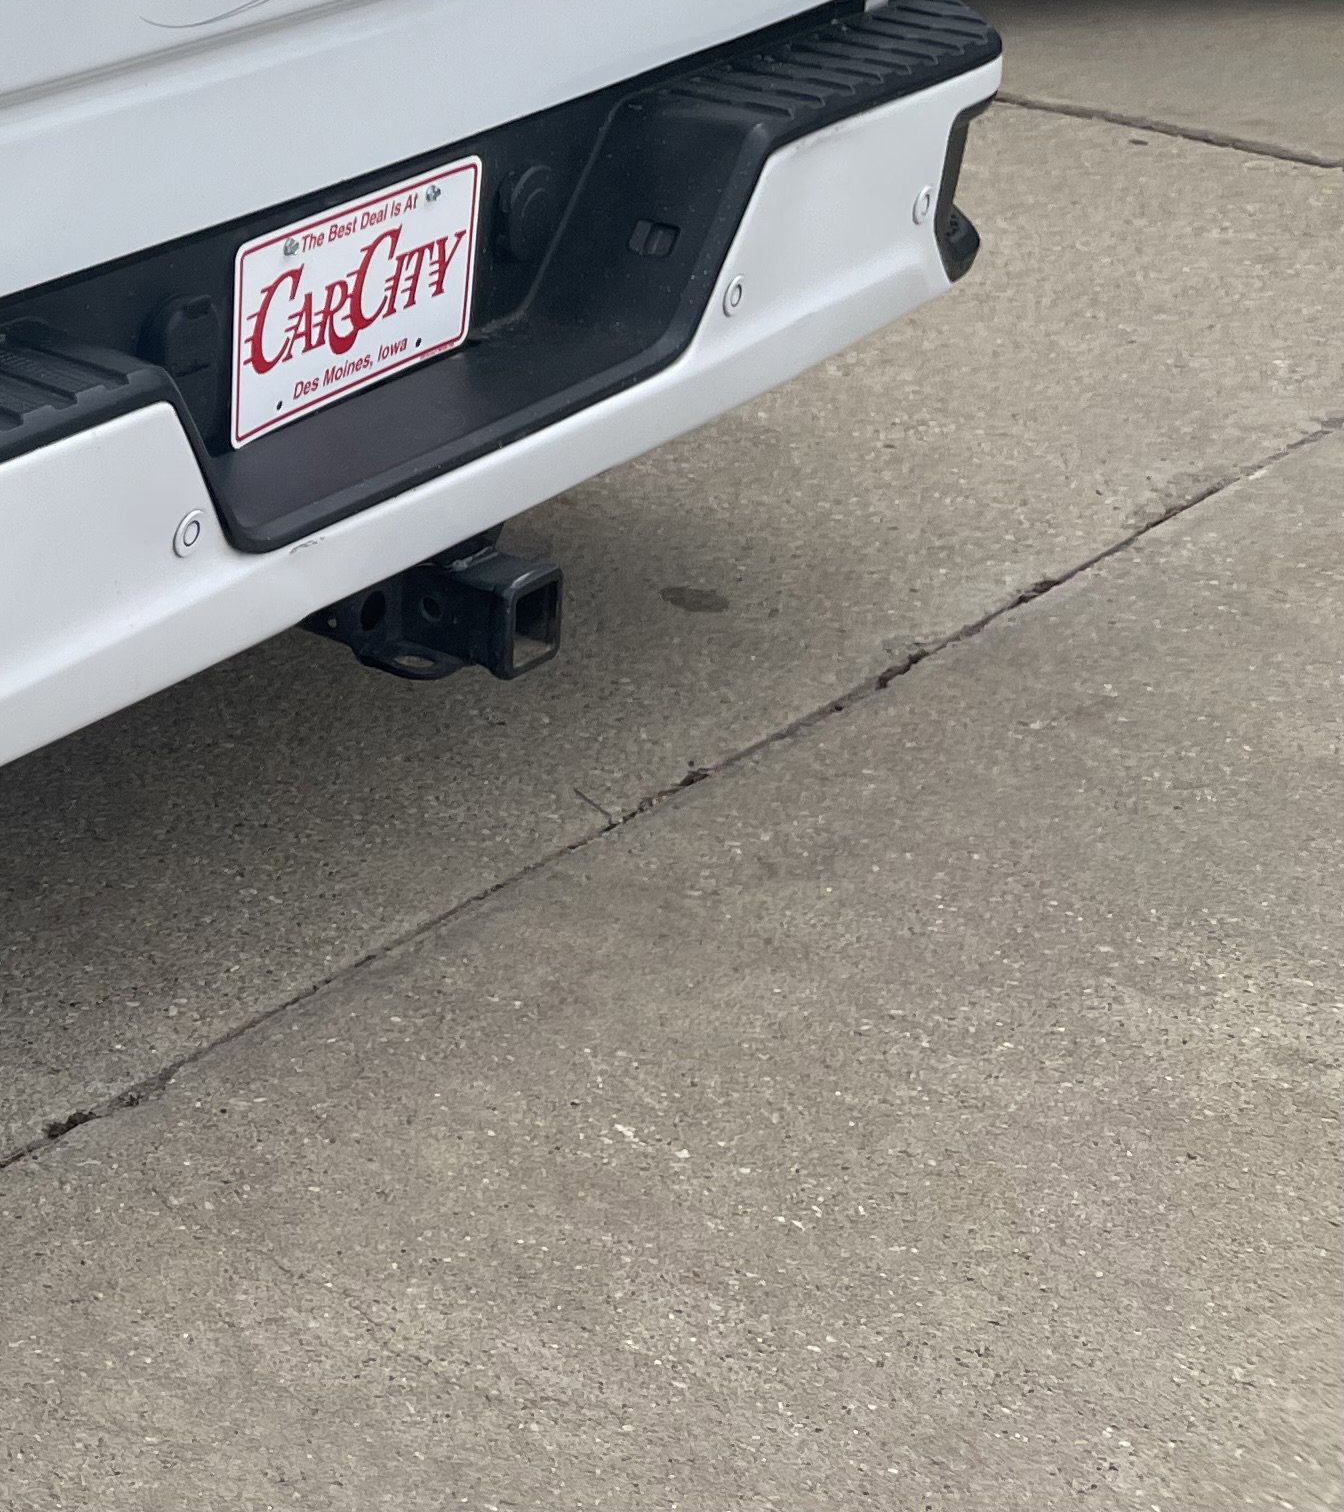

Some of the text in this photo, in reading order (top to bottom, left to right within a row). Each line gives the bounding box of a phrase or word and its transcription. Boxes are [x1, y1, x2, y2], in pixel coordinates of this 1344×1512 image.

[301, 193, 418, 253] The Best Deal Is At
[293, 377, 320, 400] Des
[323, 354, 373, 387] Moines,
[378, 338, 408, 362] Iowa
